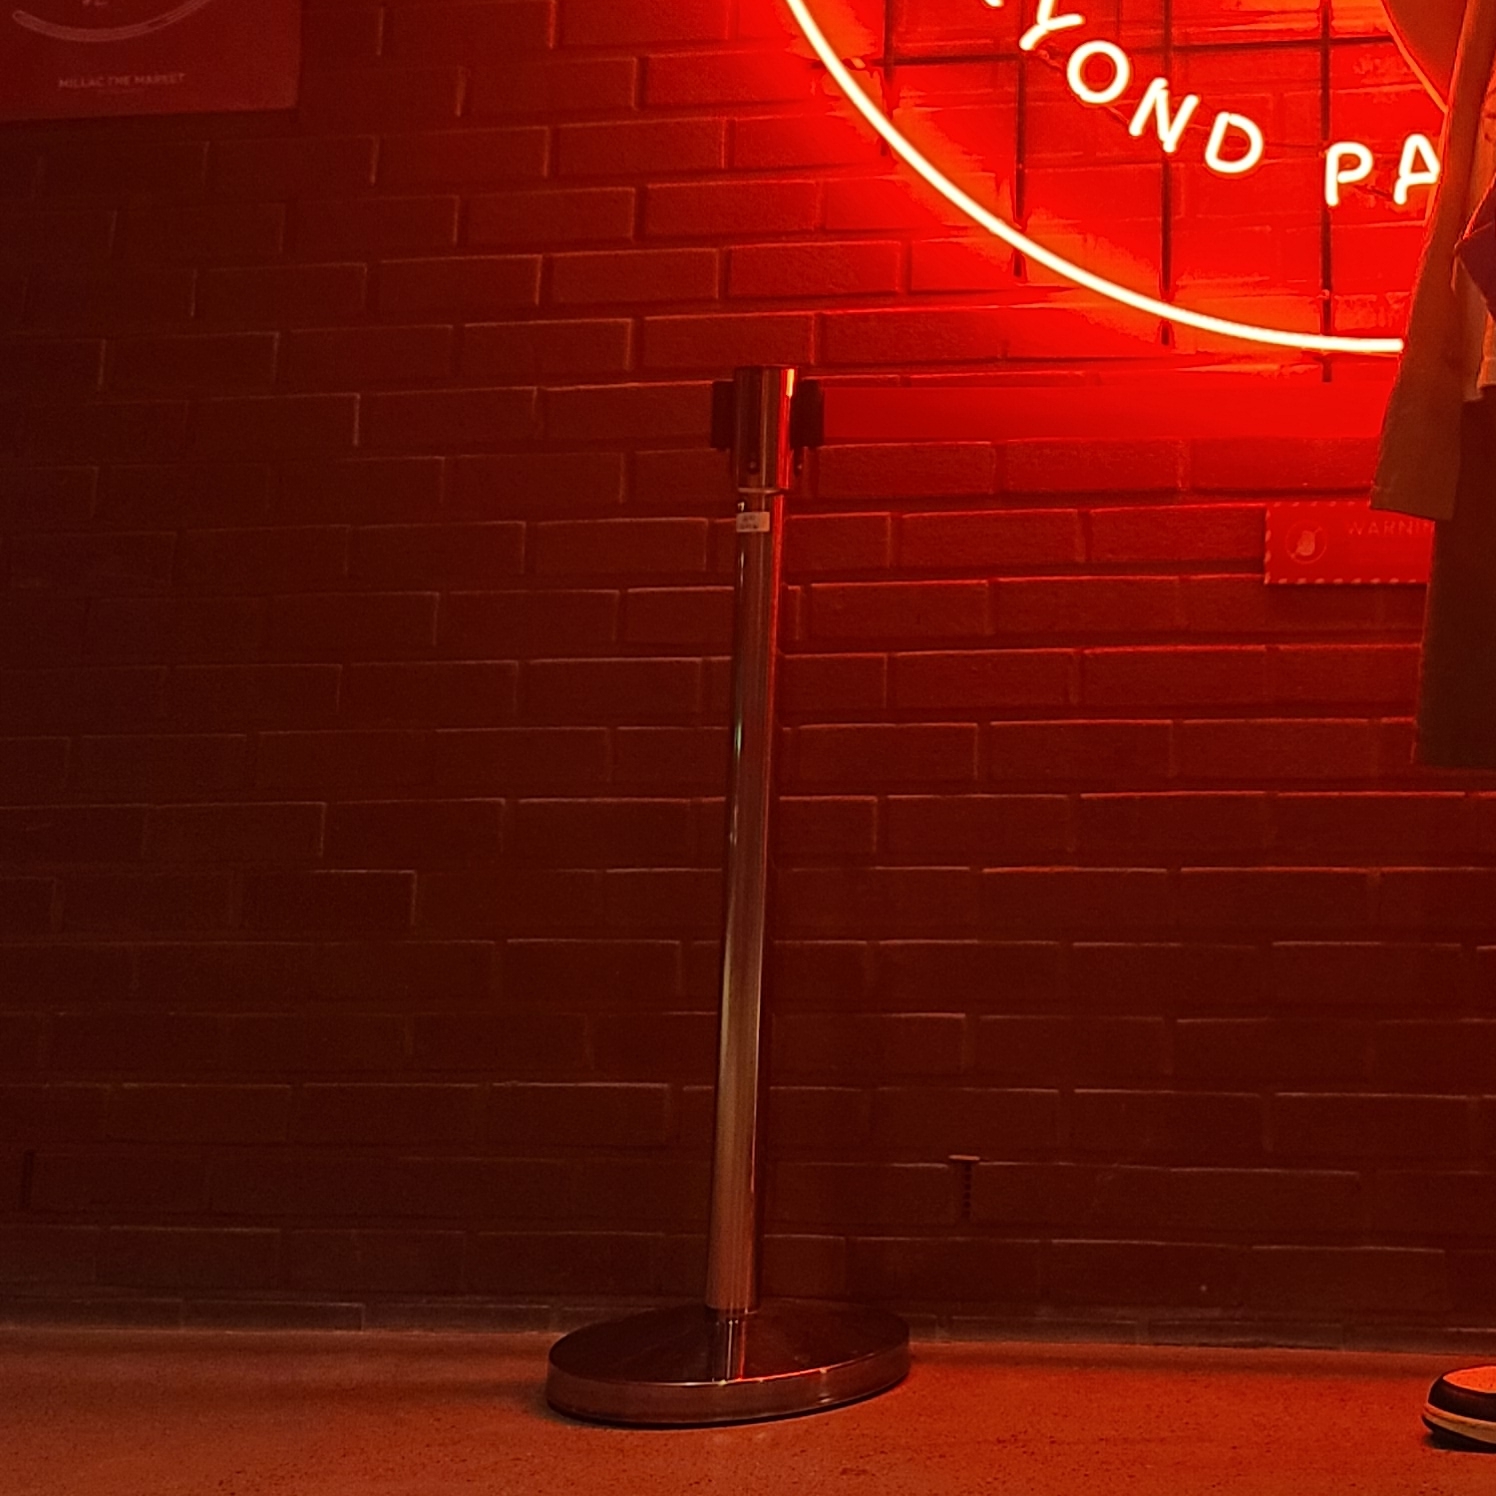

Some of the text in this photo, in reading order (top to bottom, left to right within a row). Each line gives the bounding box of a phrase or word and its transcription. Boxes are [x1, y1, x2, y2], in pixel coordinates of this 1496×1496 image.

[58, 72, 187, 88] MILLAC THE MARKET
